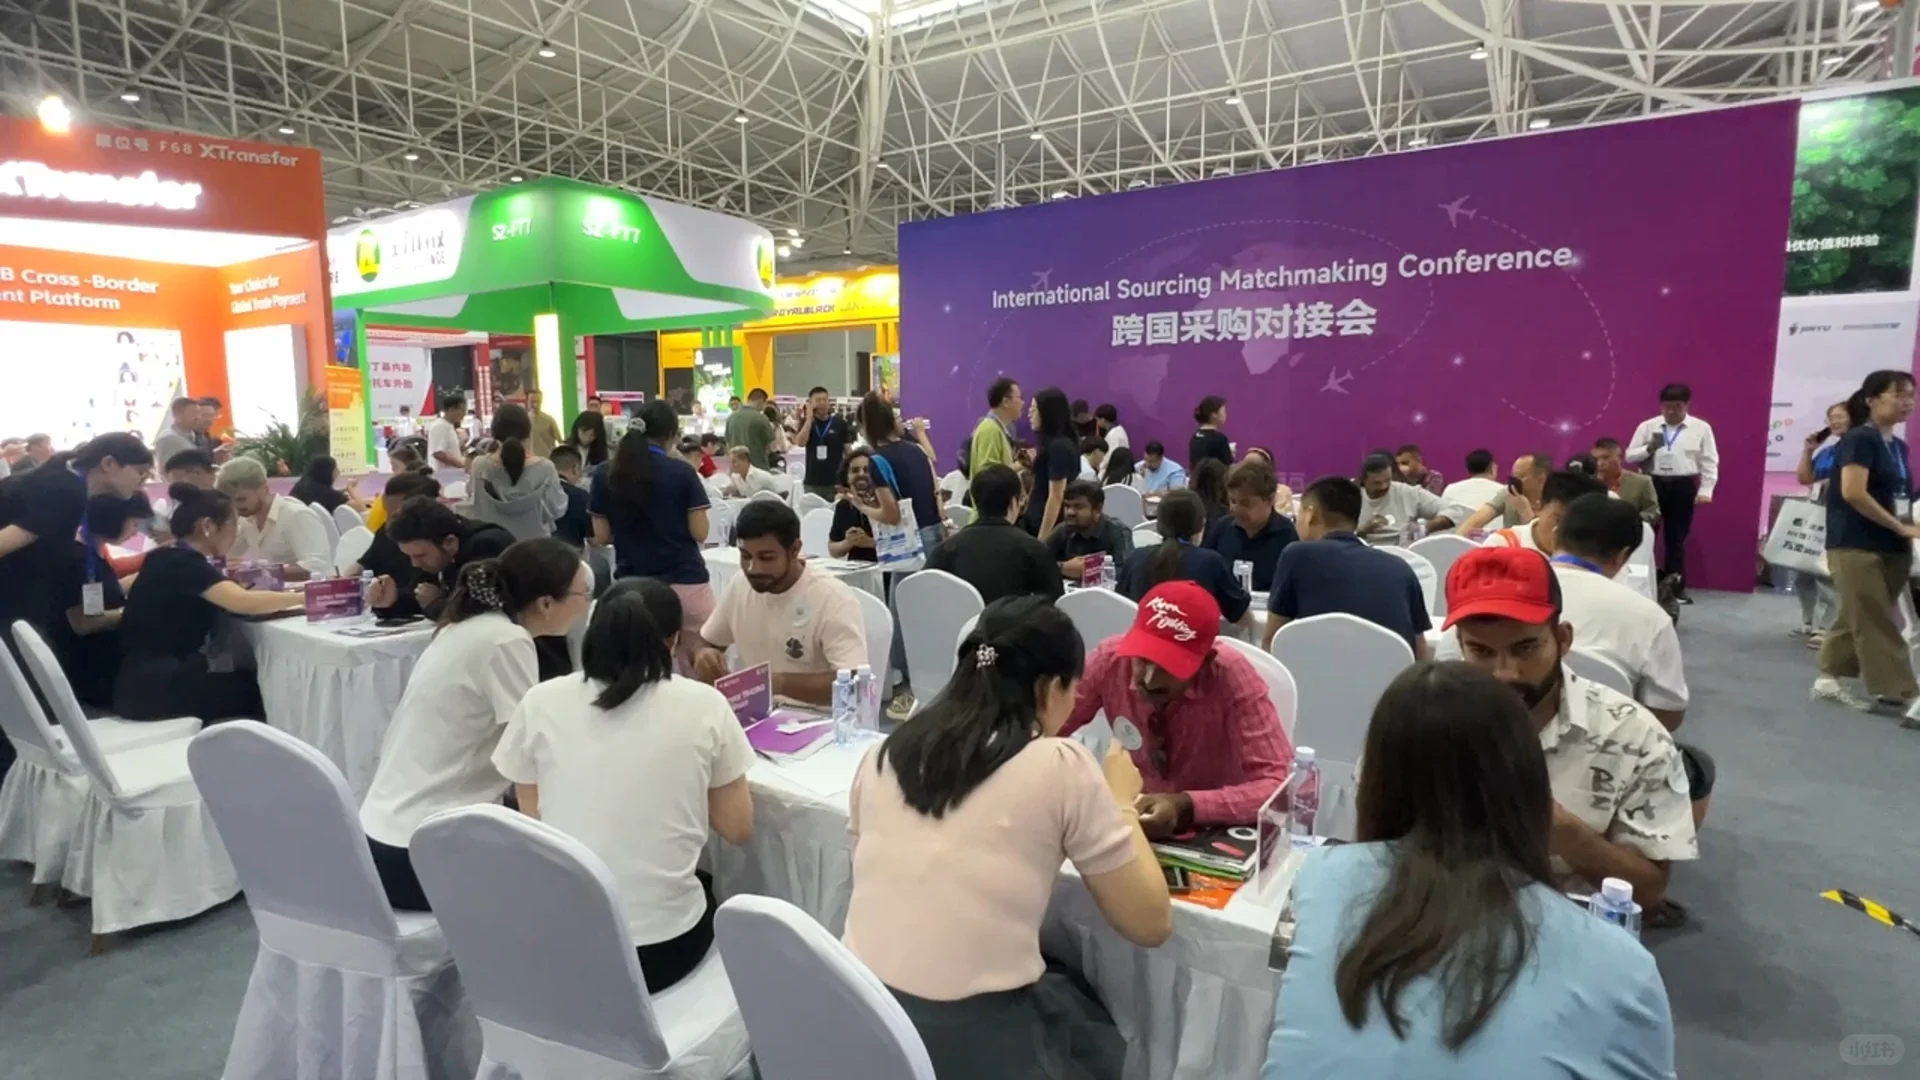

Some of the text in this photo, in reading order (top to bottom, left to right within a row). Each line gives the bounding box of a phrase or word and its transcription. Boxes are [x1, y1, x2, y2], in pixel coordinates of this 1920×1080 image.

[159, 140, 193, 155] F68
[199, 143, 299, 167] XTransfer
[21, 268, 80, 286] Cross
[992, 246, 1573, 309] International Sourcing Matchmaking Conference
[30, 289, 121, 310] Platform
[1111, 298, 1377, 347] 跨国采购对接会
